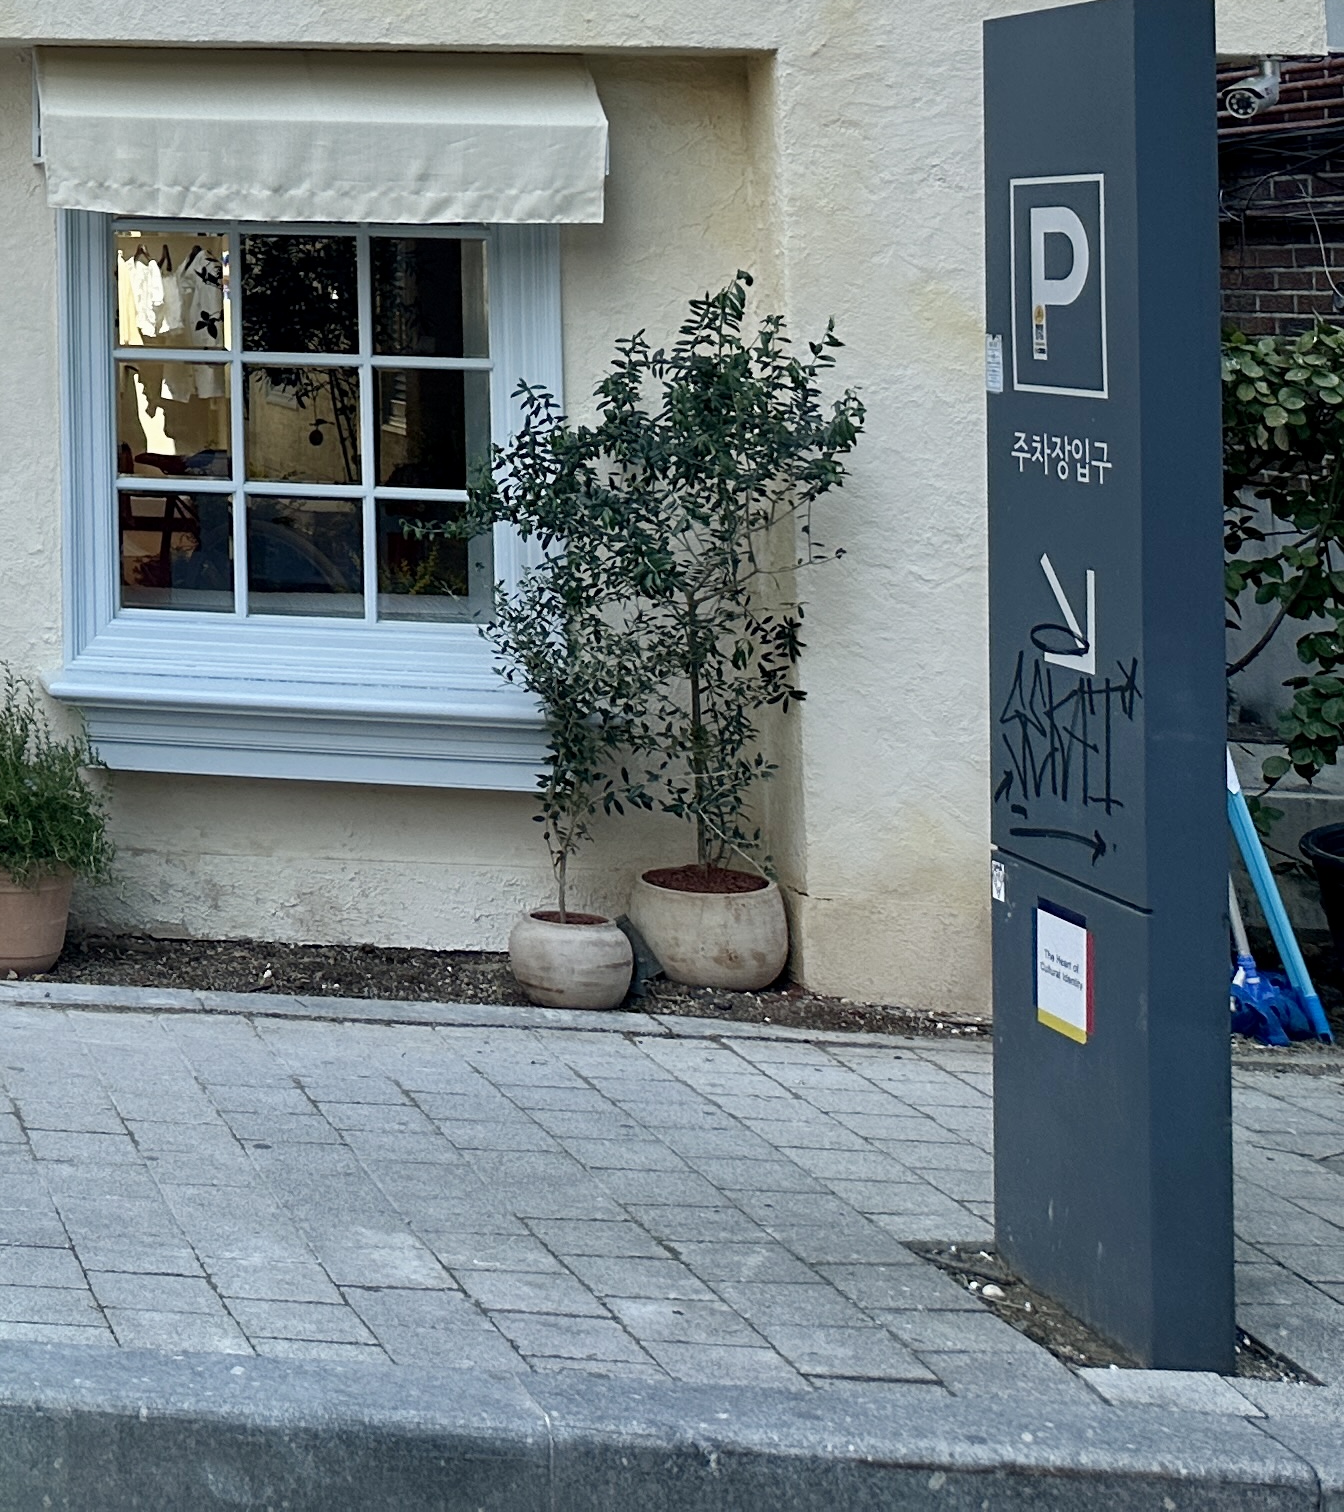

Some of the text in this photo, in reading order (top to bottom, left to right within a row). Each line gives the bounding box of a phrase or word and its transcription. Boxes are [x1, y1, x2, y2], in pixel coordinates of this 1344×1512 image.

[1031, 206, 1090, 360] P
[1011, 431, 1112, 484] 주차장입구
[1040, 961, 1061, 980] Cultural
[1044, 948, 1079, 973] The Heart of
